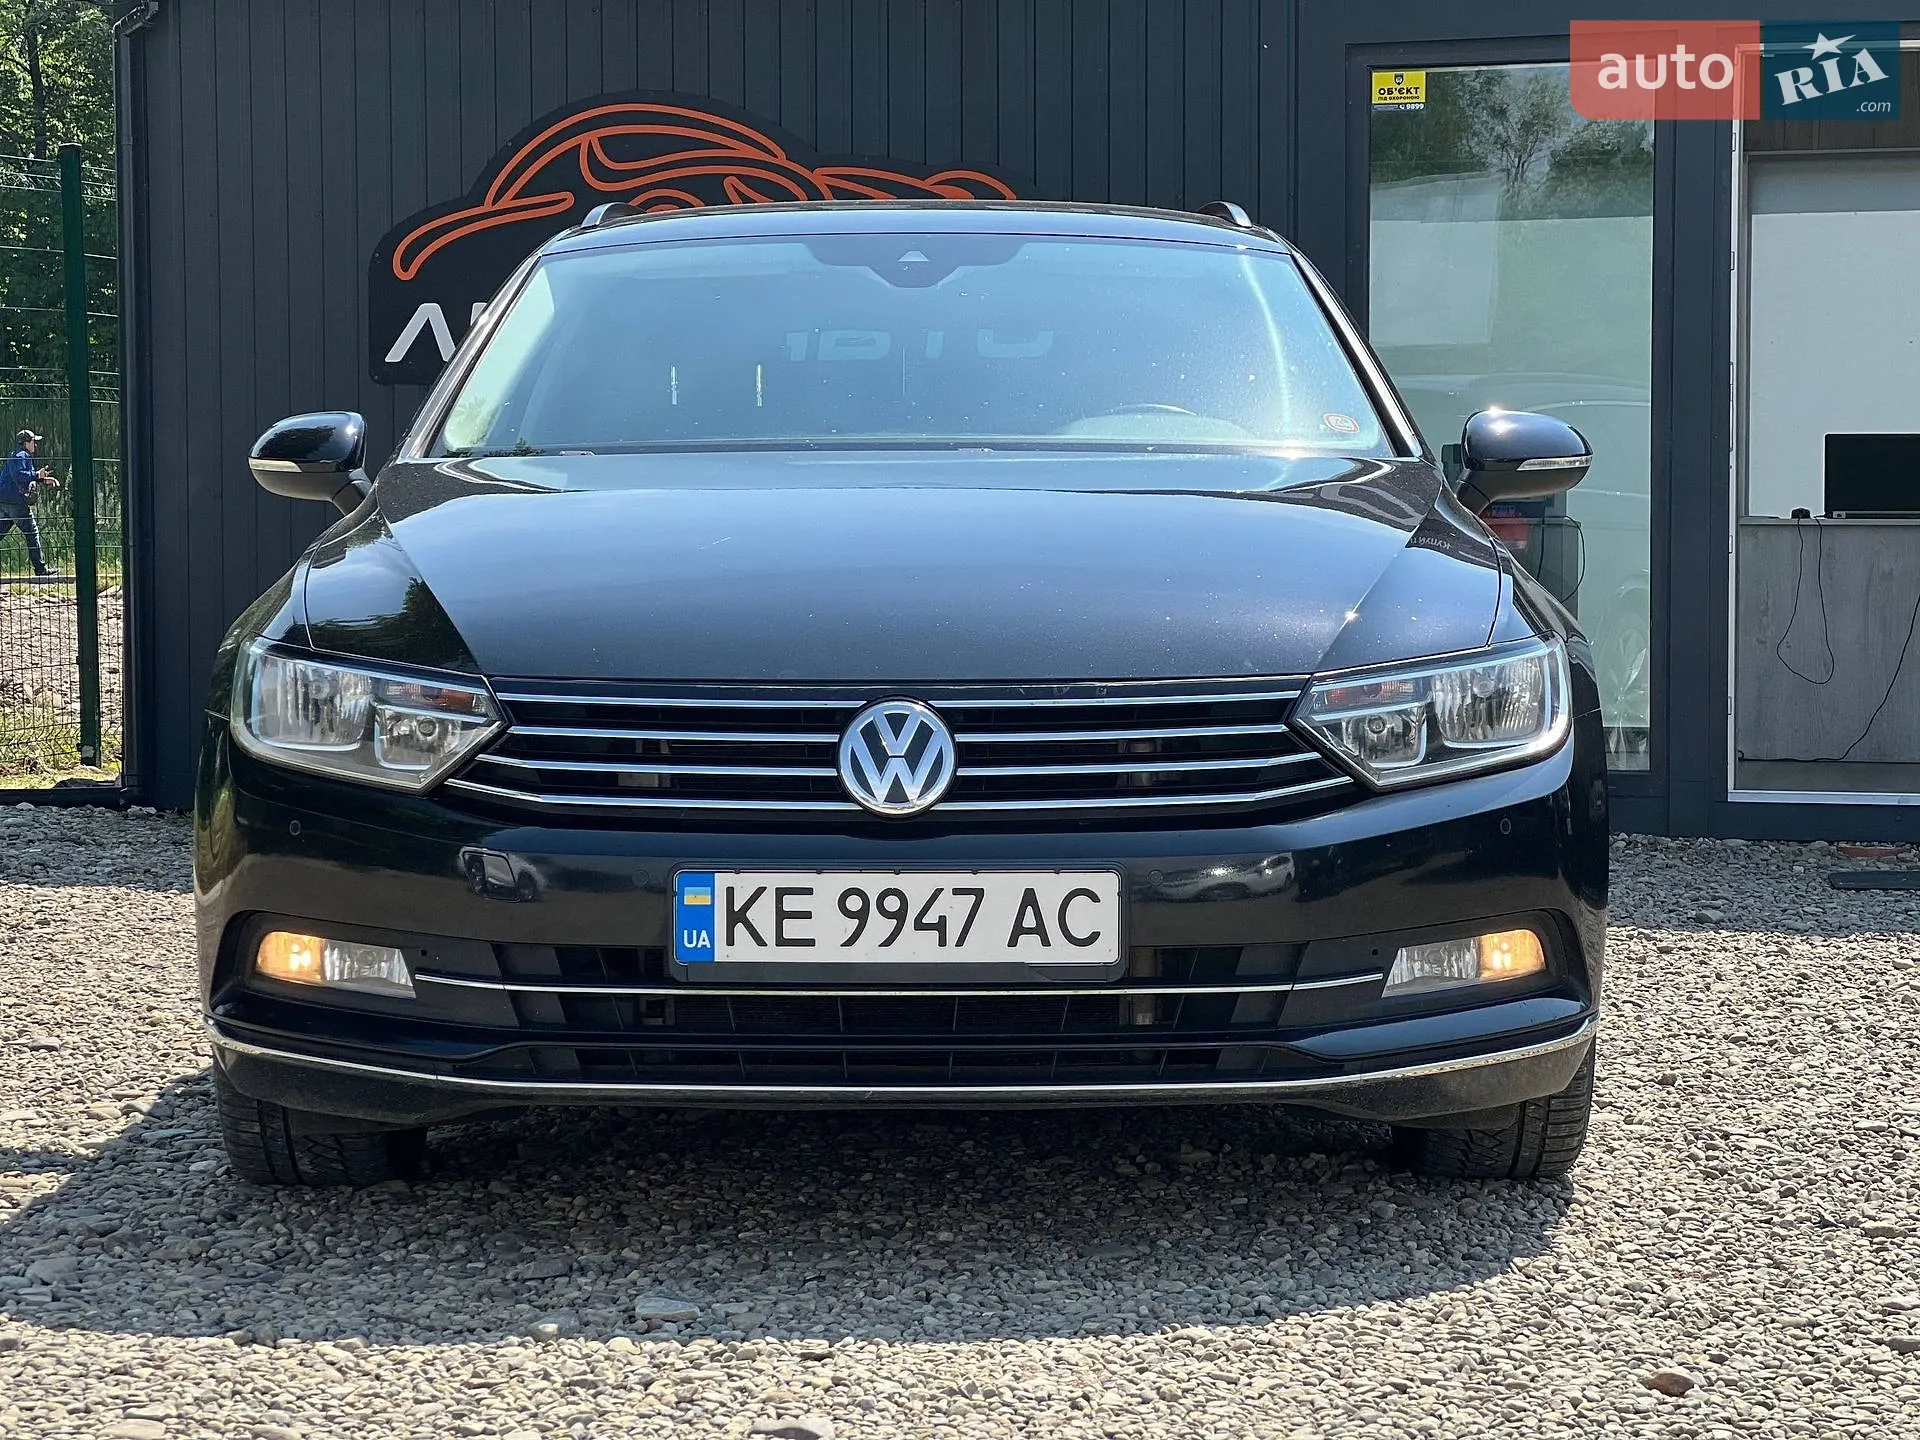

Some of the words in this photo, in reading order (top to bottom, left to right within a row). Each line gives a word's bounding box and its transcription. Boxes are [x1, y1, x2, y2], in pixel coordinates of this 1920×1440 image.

[725, 886, 816, 947] KE
[837, 887, 985, 947] 9947
[1006, 887, 1101, 947] AC
[683, 929, 712, 949] UA
